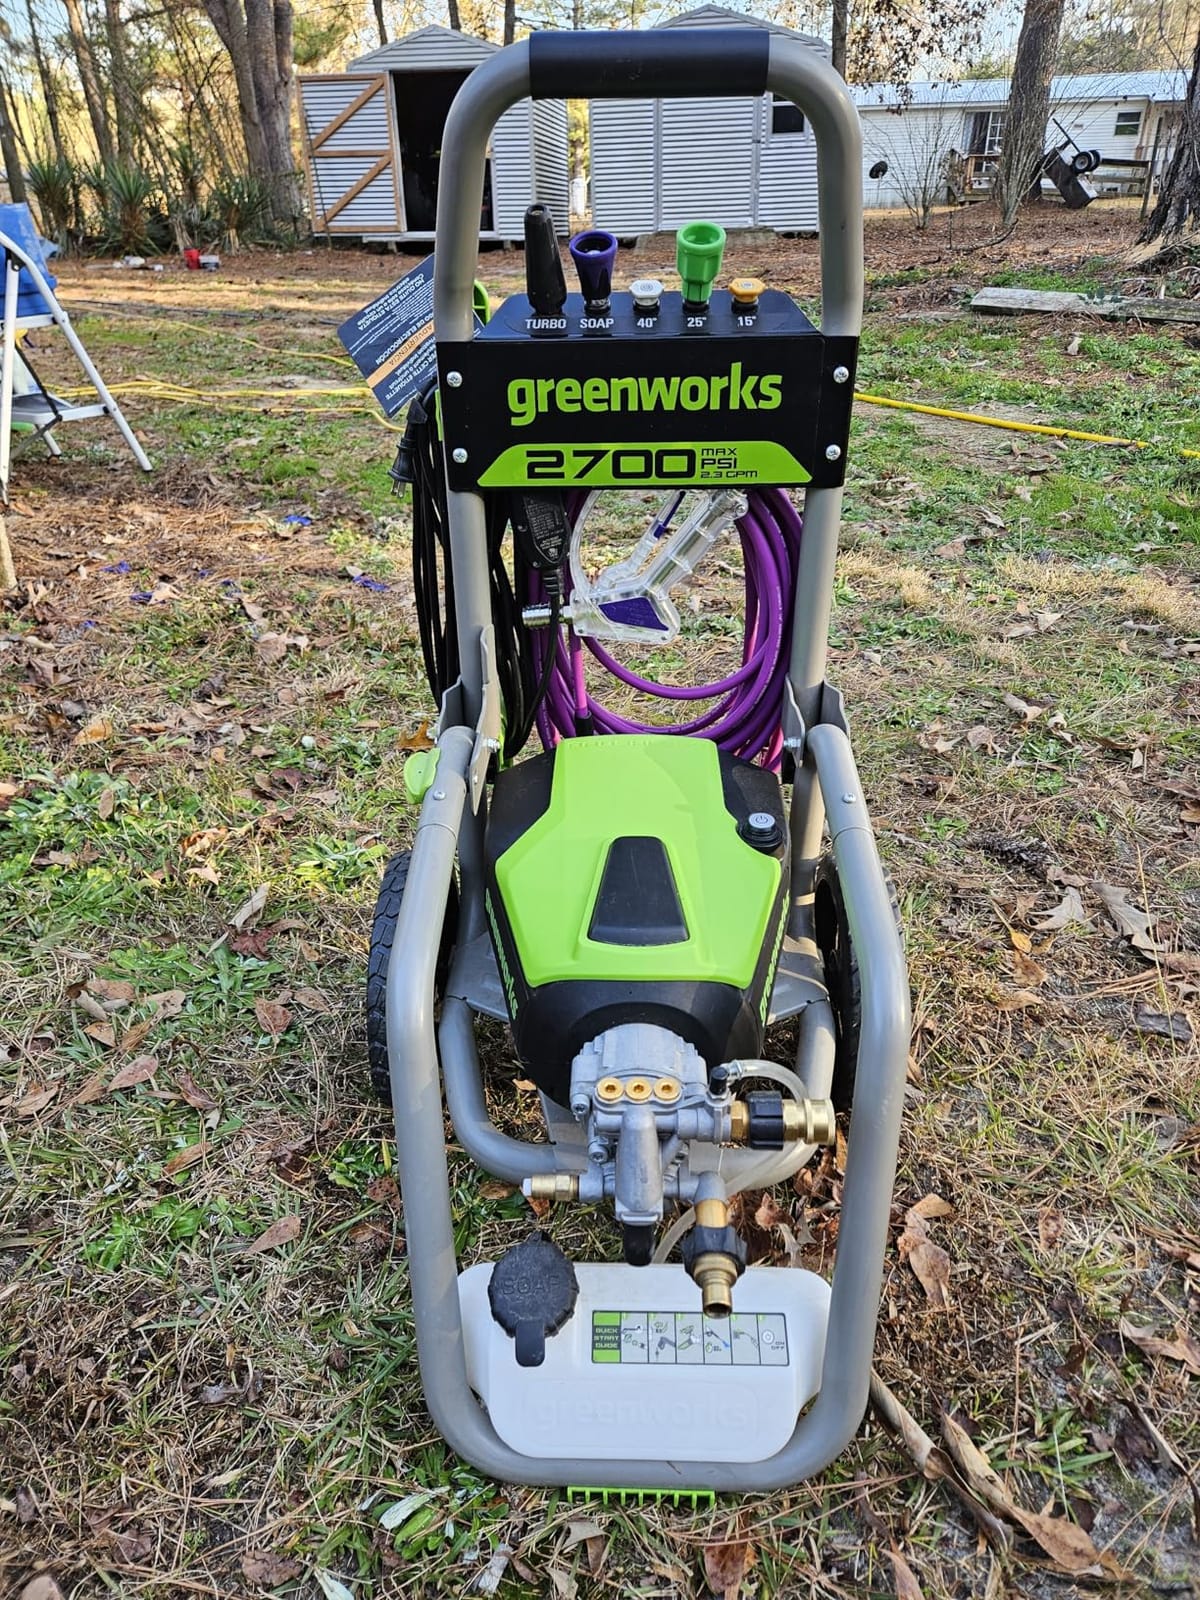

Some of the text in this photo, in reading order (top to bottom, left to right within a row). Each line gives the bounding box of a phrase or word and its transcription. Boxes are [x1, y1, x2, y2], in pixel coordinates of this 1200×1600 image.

[398, 285, 416, 300] QUITE
[358, 308, 385, 330] ETIQUETA
[525, 319, 567, 329] TURBO
[580, 318, 614, 329] SOAP
[388, 323, 433, 366] ADVERTENCIA
[411, 360, 429, 377] CETTE
[507, 362, 783, 426] greenworks
[701, 447, 737, 456] MAX
[526, 449, 696, 480] 2700
[701, 458, 737, 470] PSI
[700, 470, 758, 479] 2.3 GPM
[503, 1275, 561, 1296] SOAP
[534, 1394, 747, 1432] greenworks
